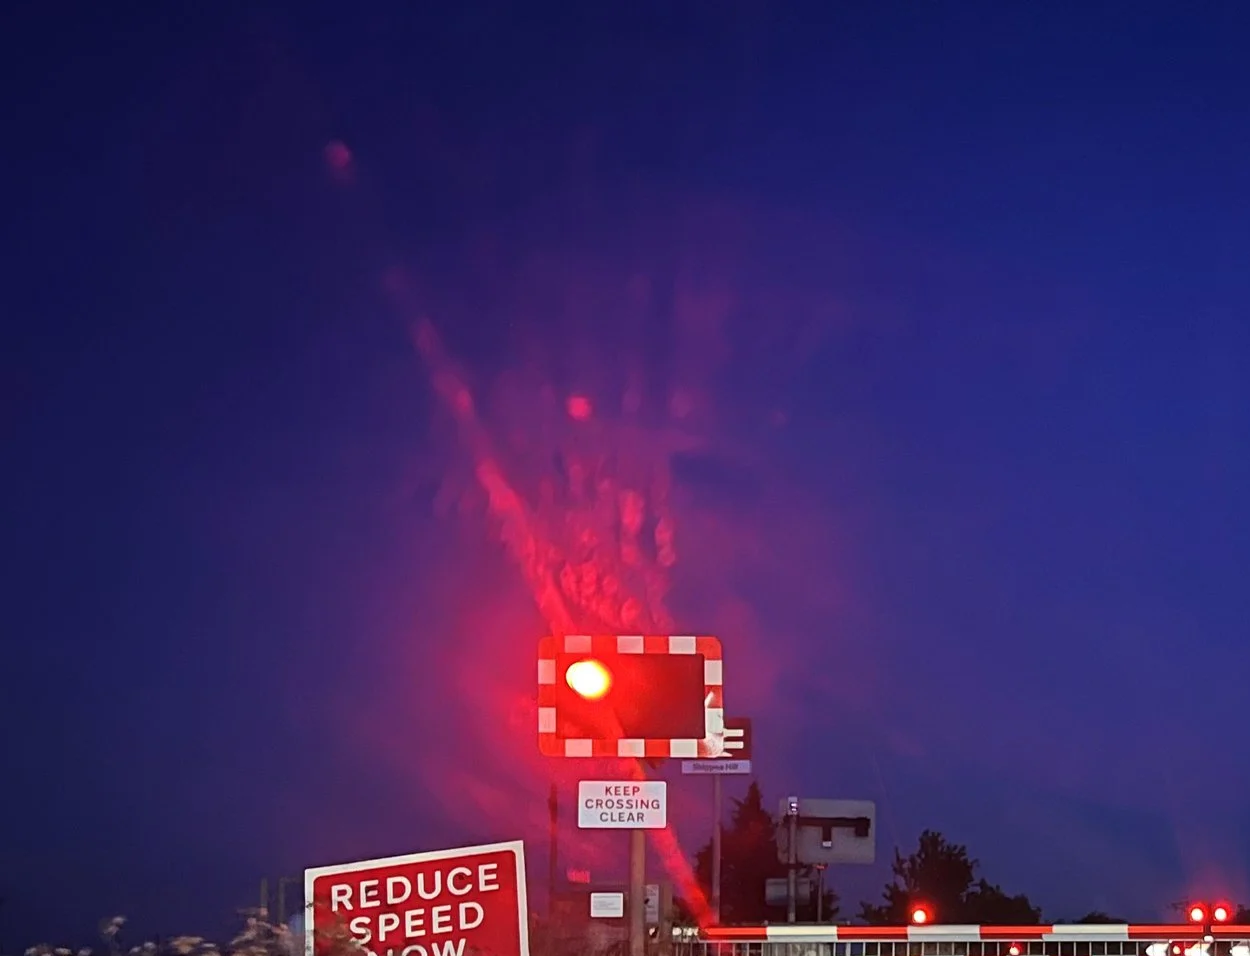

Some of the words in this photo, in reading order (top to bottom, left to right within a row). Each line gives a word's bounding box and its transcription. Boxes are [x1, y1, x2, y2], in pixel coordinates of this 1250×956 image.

[605, 786, 640, 796] KEEP
[585, 799, 660, 809] CROSSING
[600, 812, 645, 823] CLEAR
[331, 863, 499, 912] REDUCE
[350, 902, 484, 946] SPEED
